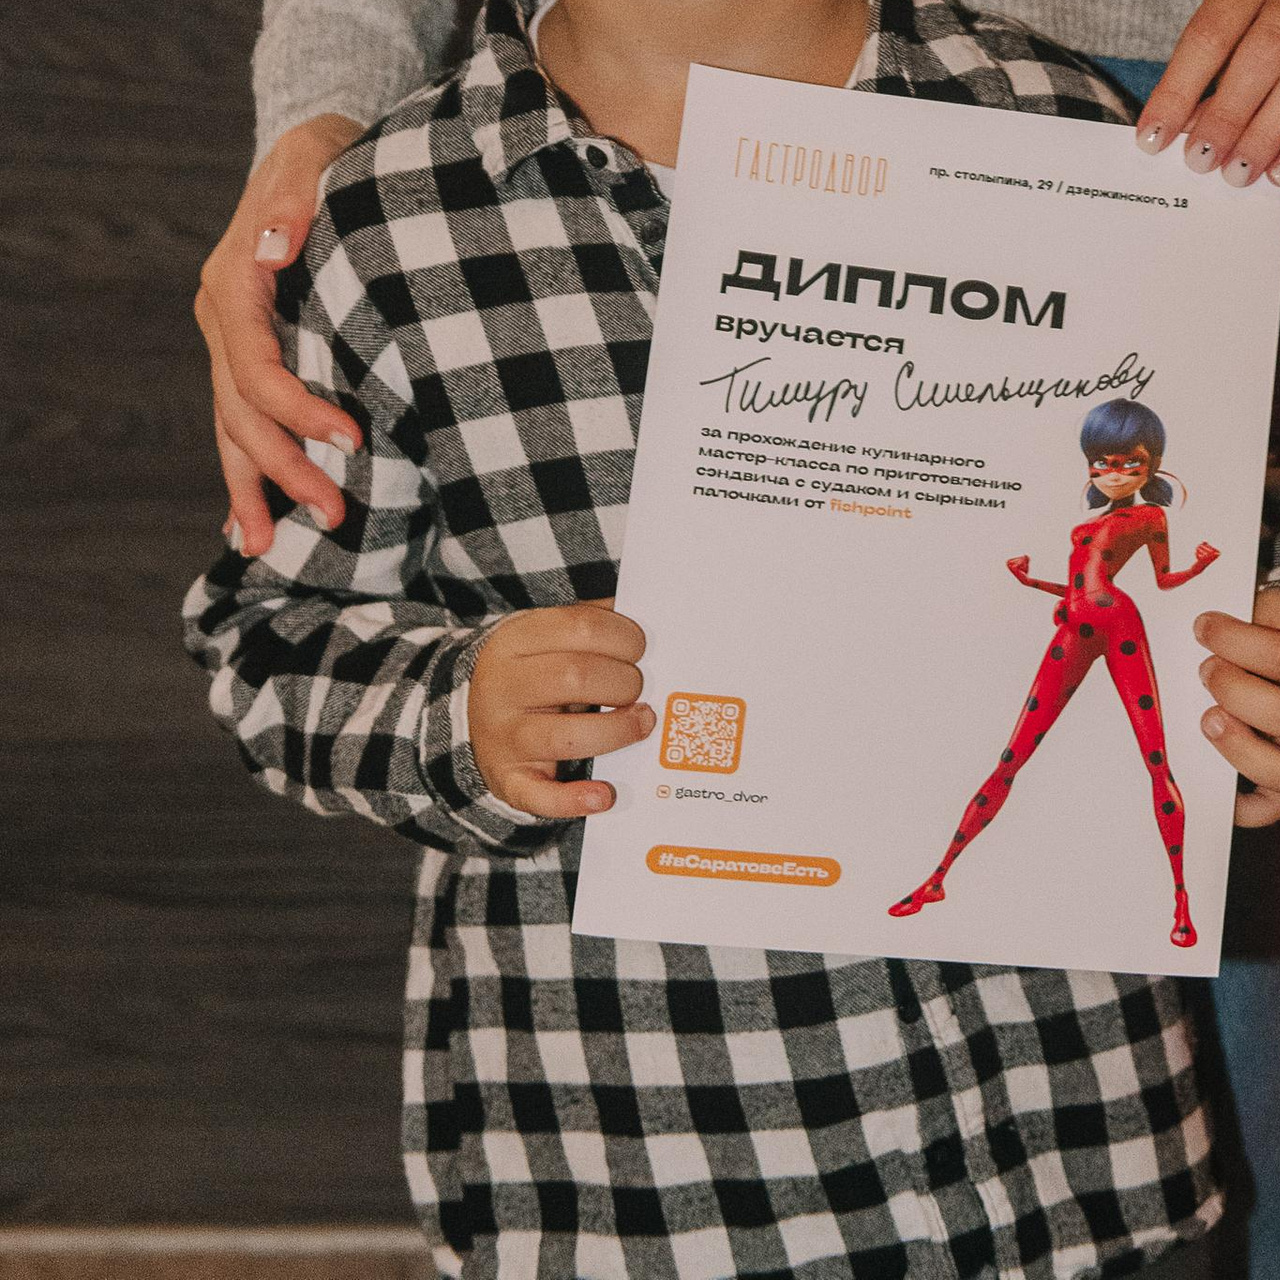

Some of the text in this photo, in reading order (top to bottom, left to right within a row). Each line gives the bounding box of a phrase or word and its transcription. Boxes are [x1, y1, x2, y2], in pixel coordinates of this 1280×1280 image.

[734, 136, 888, 198] ГАСТРОДВОР
[929, 166, 950, 179] пр.
[954, 169, 1033, 191] столыпина,
[1036, 179, 1054, 191] 29
[1065, 184, 1170, 208] дзержинского,
[1172, 197, 1189, 209] 18
[720, 249, 1067, 330] ДИПЛОМ
[715, 314, 906, 355] вручается
[699, 356, 868, 423] Тимуру
[697, 446, 1023, 492] мастер-класса по приготовлению
[700, 427, 986, 470] за прохождение кулинарного
[692, 485, 913, 520] палочками от fishpoint
[695, 465, 1006, 509] сэндвича с судаком и сырными
[674, 786, 769, 803] gastro_dvor
[658, 852, 830, 878] #вСаратовеЕсть
